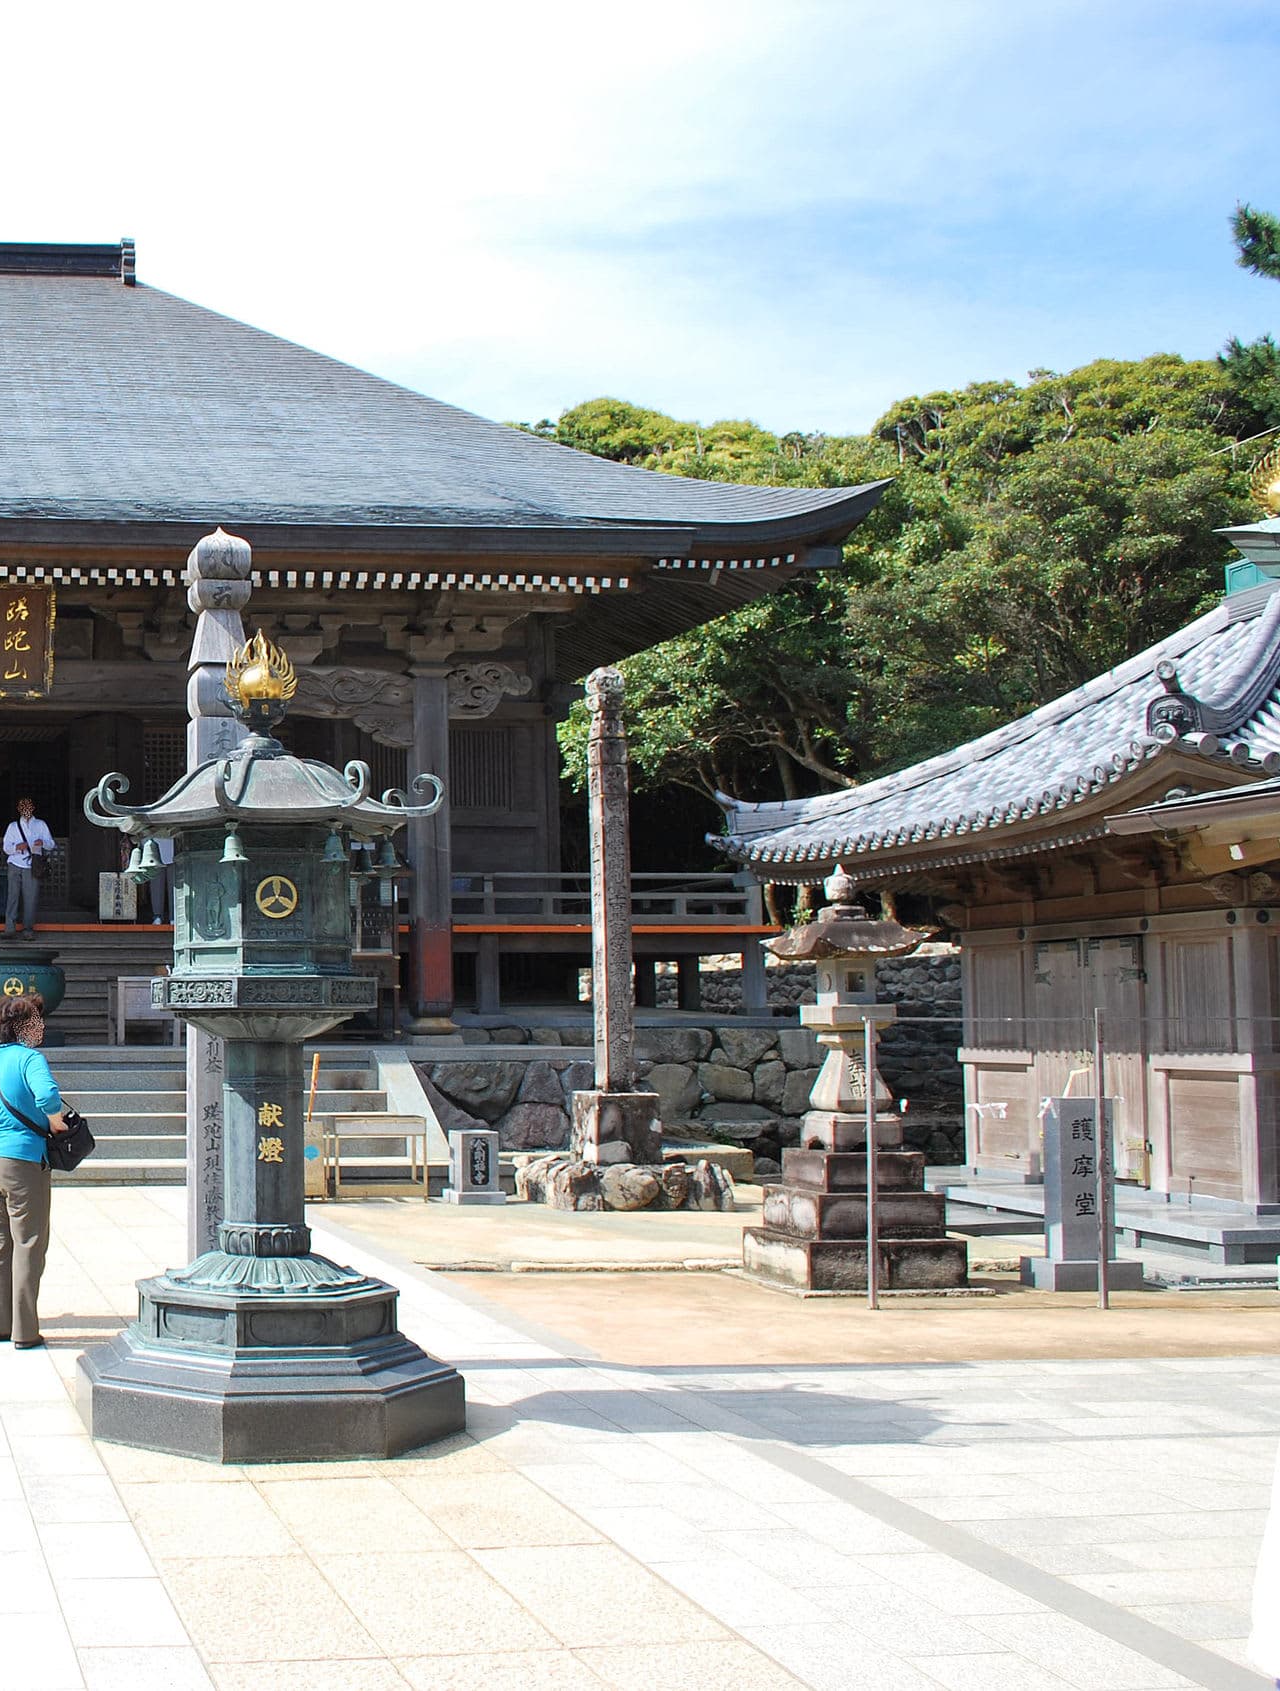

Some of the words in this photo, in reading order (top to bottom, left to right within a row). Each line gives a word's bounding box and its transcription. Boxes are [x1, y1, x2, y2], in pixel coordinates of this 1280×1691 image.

[257, 1101, 285, 1164] 献燈
[1072, 1118, 1096, 1217] 護摩堂
